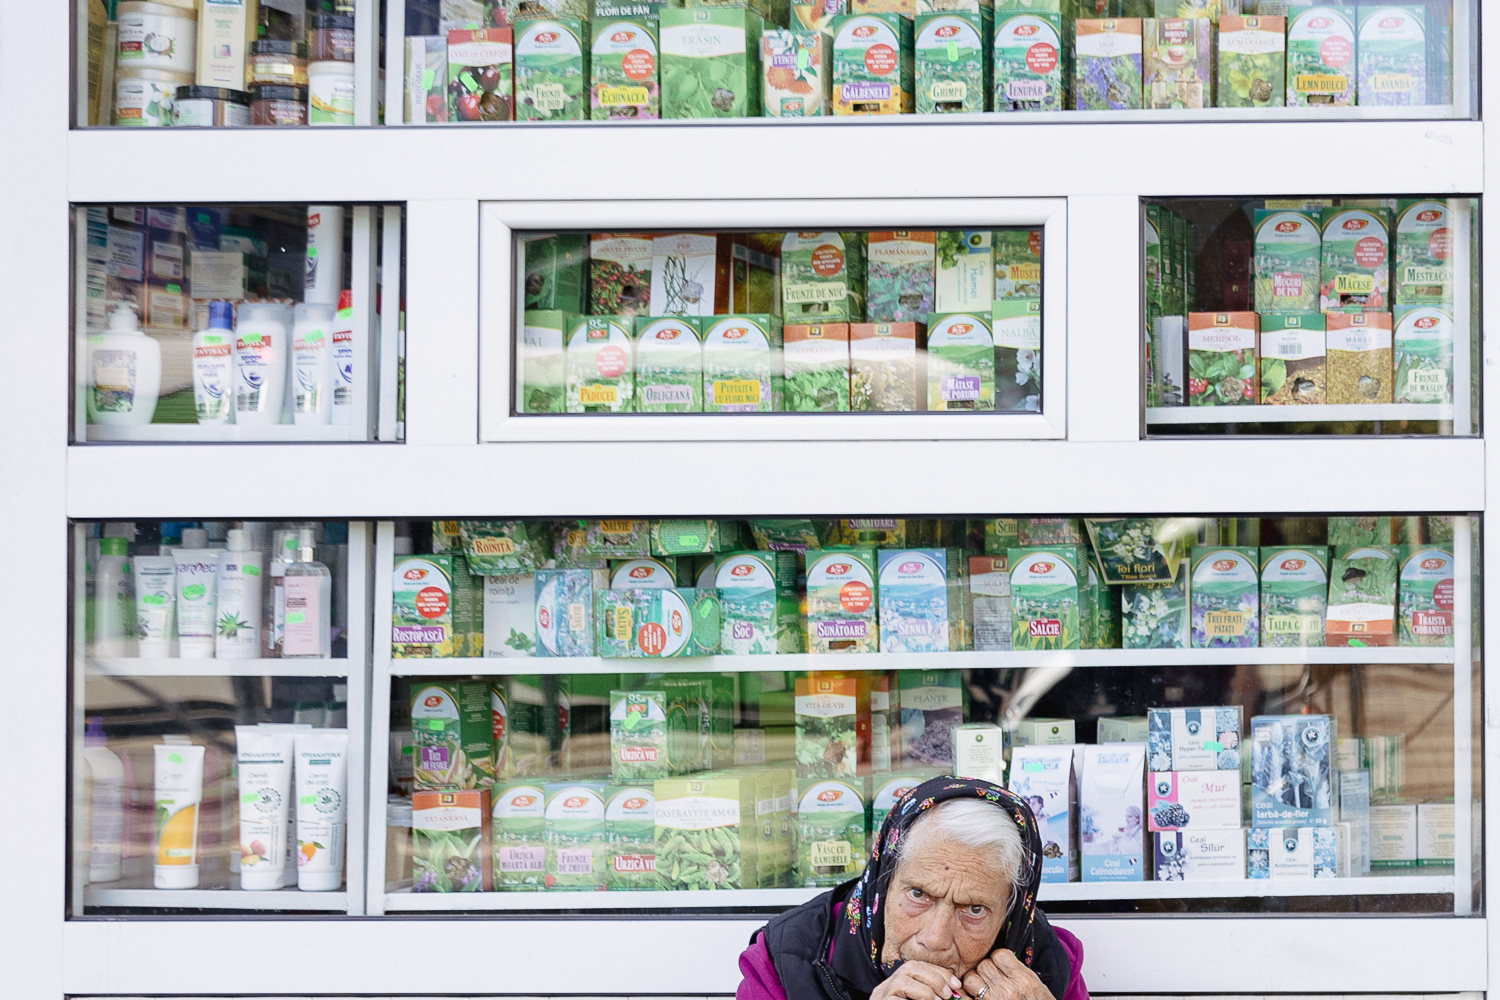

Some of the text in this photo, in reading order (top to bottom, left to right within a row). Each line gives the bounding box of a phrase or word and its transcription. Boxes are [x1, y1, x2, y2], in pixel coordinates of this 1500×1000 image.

[596, 7, 619, 16] FLORI
[621, 7, 632, 16] DE
[1296, 76, 1346, 90] LEMN DULCE
[536, 87, 562, 98] FRUNZE
[602, 89, 646, 103] ECHINACEA
[933, 86, 964, 97] GHIMPE
[1274, 276, 1301, 287] MUGURI
[786, 287, 844, 300] FRUNZE DE NUC
[1277, 287, 1299, 296] DE PIN
[1414, 374, 1439, 383] FRUNZE
[647, 388, 691, 402] OBLIGEANĂ
[1116, 563, 1155, 573] Tei flori
[617, 609, 631, 638] SALVIE
[1207, 613, 1222, 624] TREI
[1418, 614, 1446, 625] TRAISTA
[818, 623, 866, 637] SUNĂTOARE
[898, 623, 927, 636] SENNA
[1030, 622, 1060, 636] SALCIE
[1268, 618, 1294, 632] TALPA
[393, 627, 444, 642] ROSTOPASCĂ
[733, 624, 752, 638] SOC
[645, 749, 656, 760] VIE
[1183, 775, 1198, 783] Ceai
[1202, 782, 1227, 793] Mur
[1190, 836, 1206, 844] Ceai
[1201, 843, 1225, 852] Silur
[1103, 859, 1120, 868] Ceai
